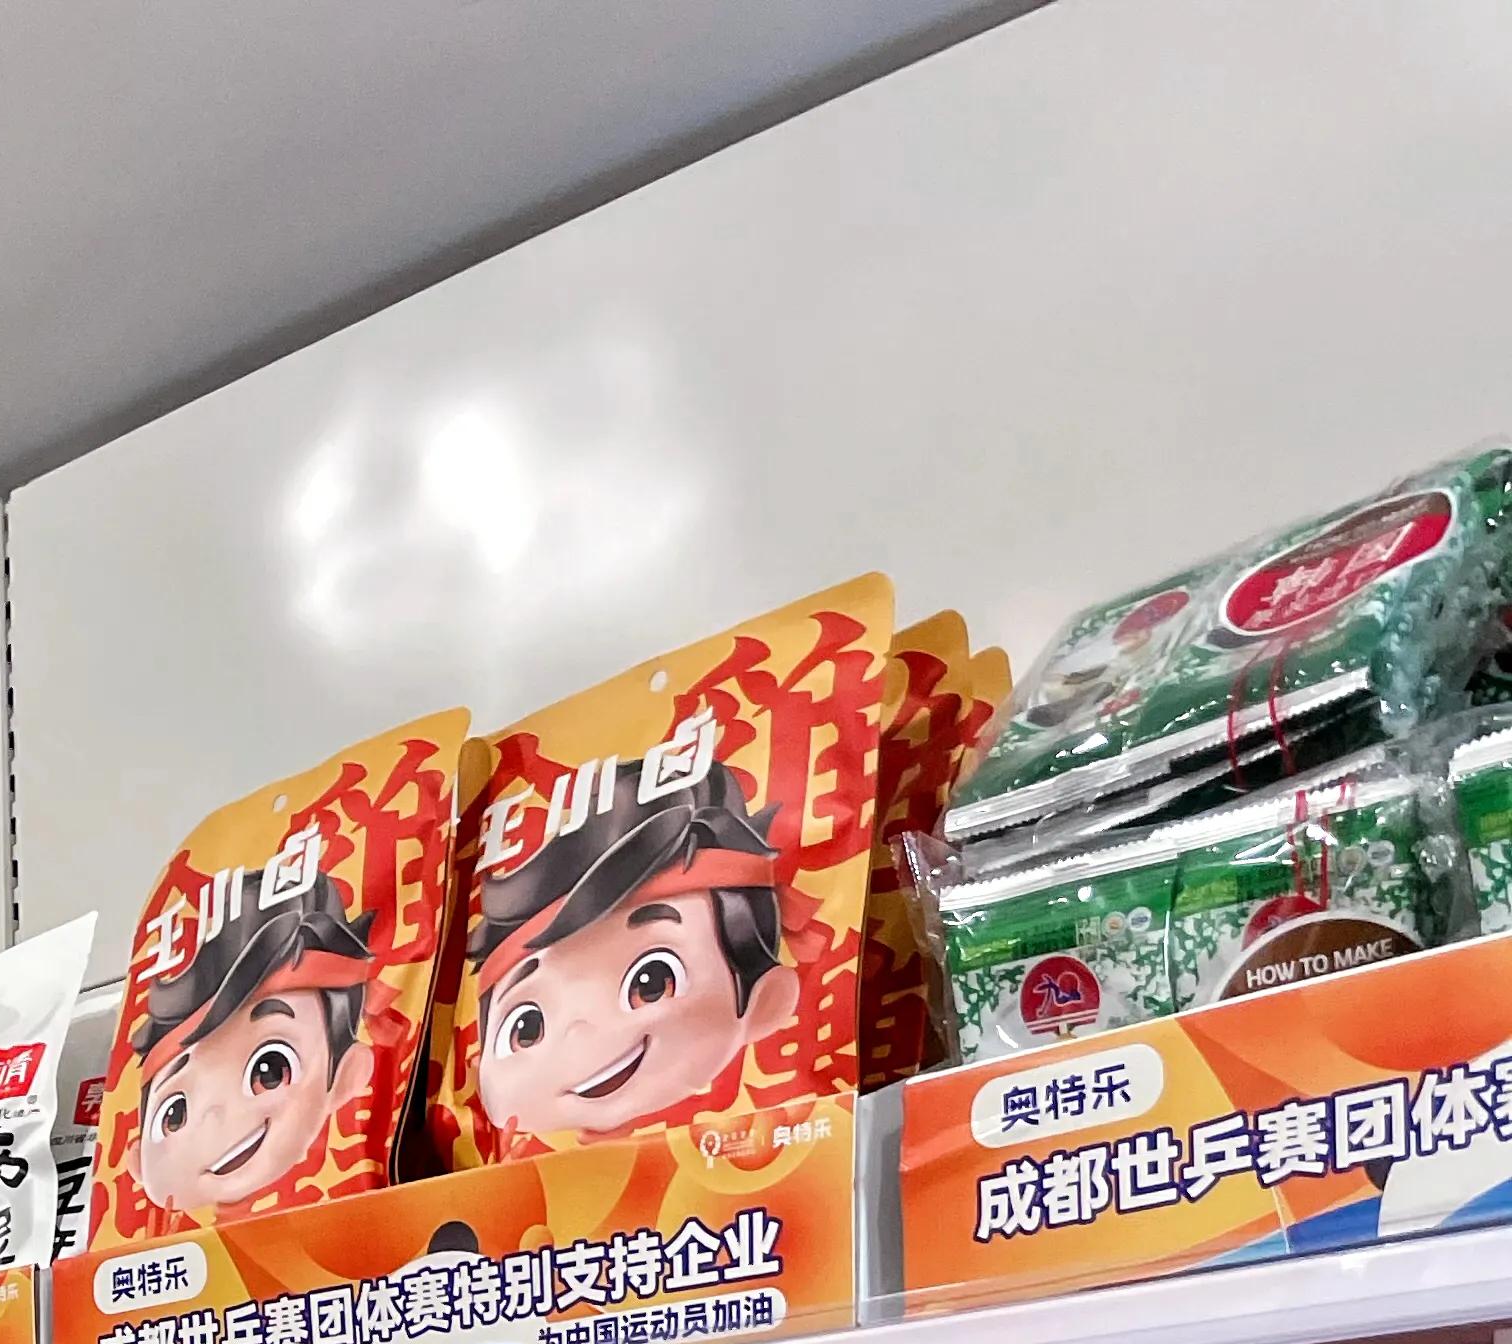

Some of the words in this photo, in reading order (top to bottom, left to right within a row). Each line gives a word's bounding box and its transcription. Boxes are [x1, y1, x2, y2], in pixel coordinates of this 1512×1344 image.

[474, 705, 716, 874] 王小卤
[137, 815, 322, 982] 王小卤
[1246, 960, 1295, 989] HOW
[1298, 955, 1329, 977] TO
[1332, 938, 1393, 971] MAKE
[1001, 1062, 1133, 1133] 奥特乐
[772, 1117, 832, 1149] 奥特乐
[110, 1255, 189, 1301] 奥特乐
